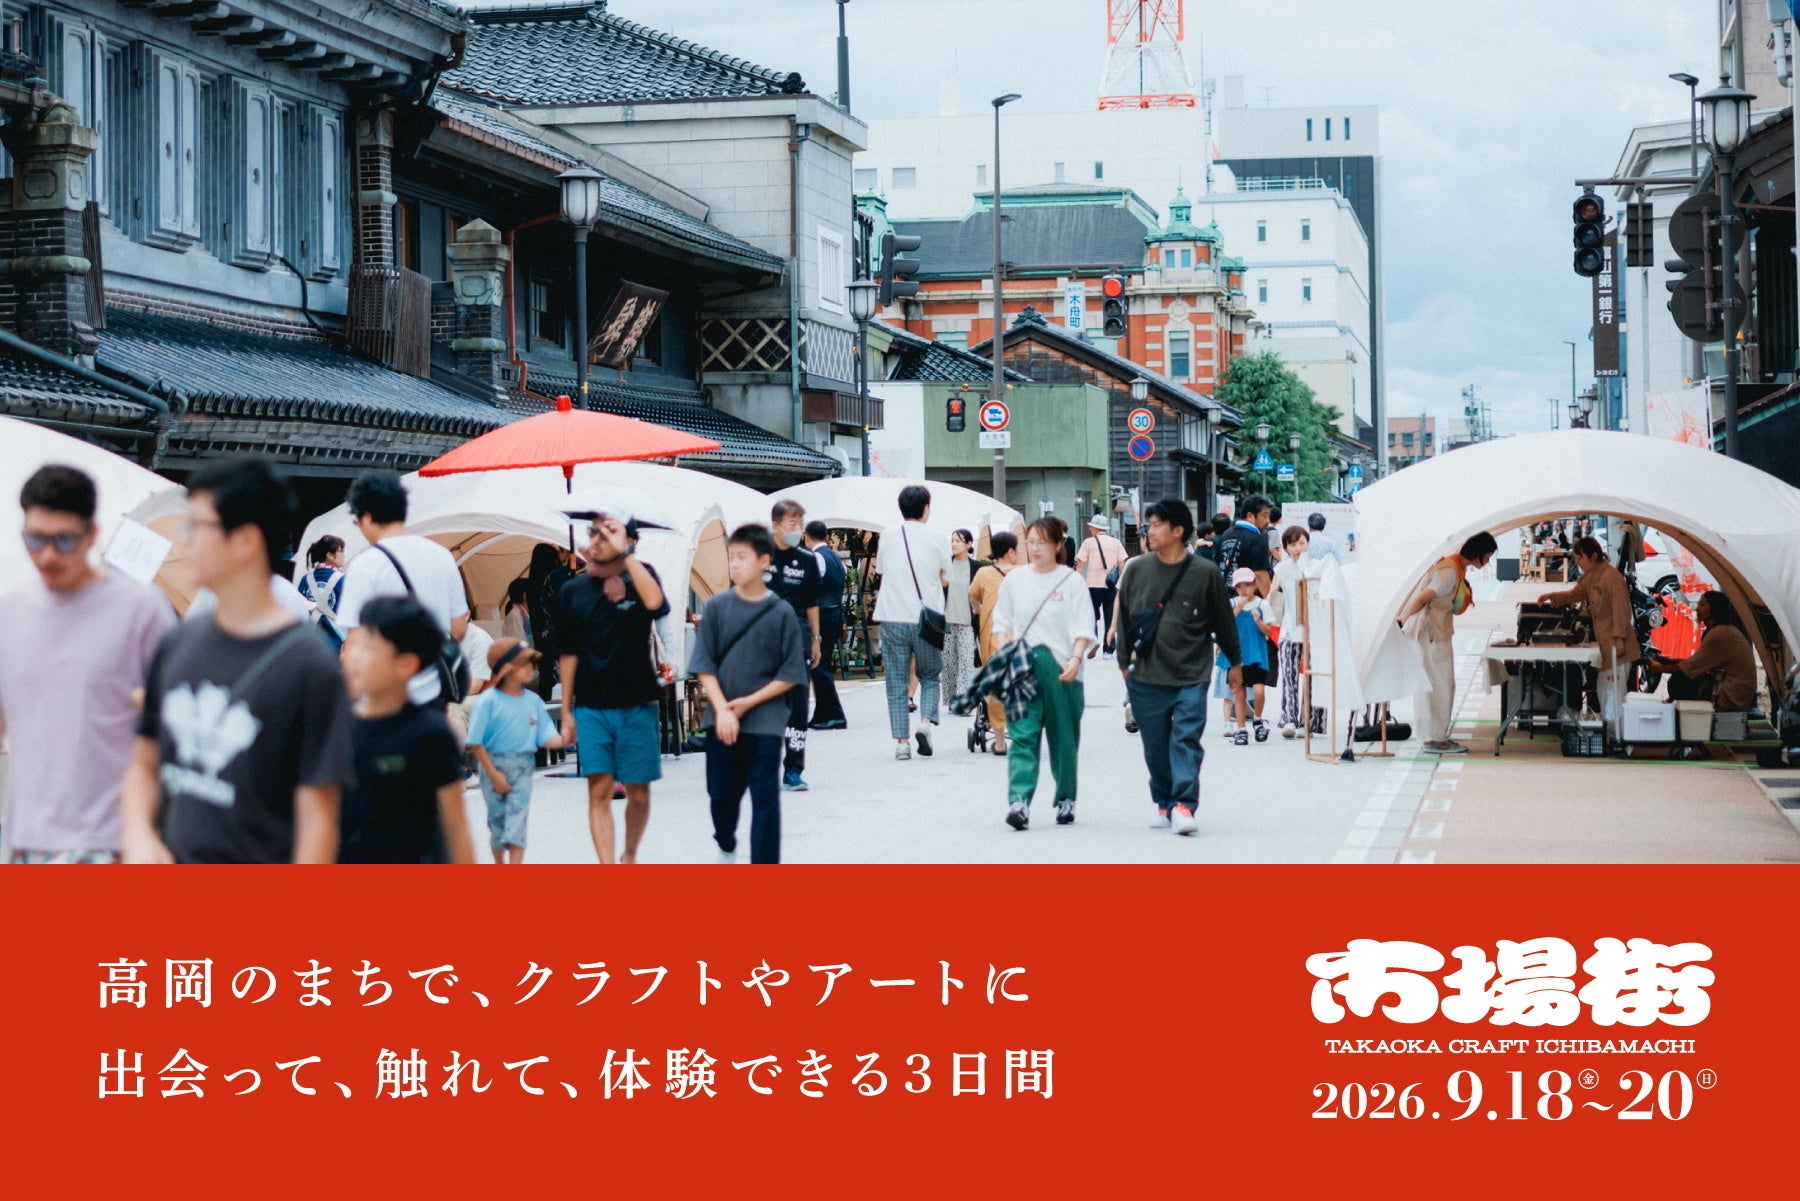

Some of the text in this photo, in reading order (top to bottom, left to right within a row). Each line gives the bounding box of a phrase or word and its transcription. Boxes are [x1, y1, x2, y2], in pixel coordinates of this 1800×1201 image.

[1069, 294, 1081, 328] 木舟町
[1134, 415, 1149, 428] 30
[790, 737, 807, 752] Sp
